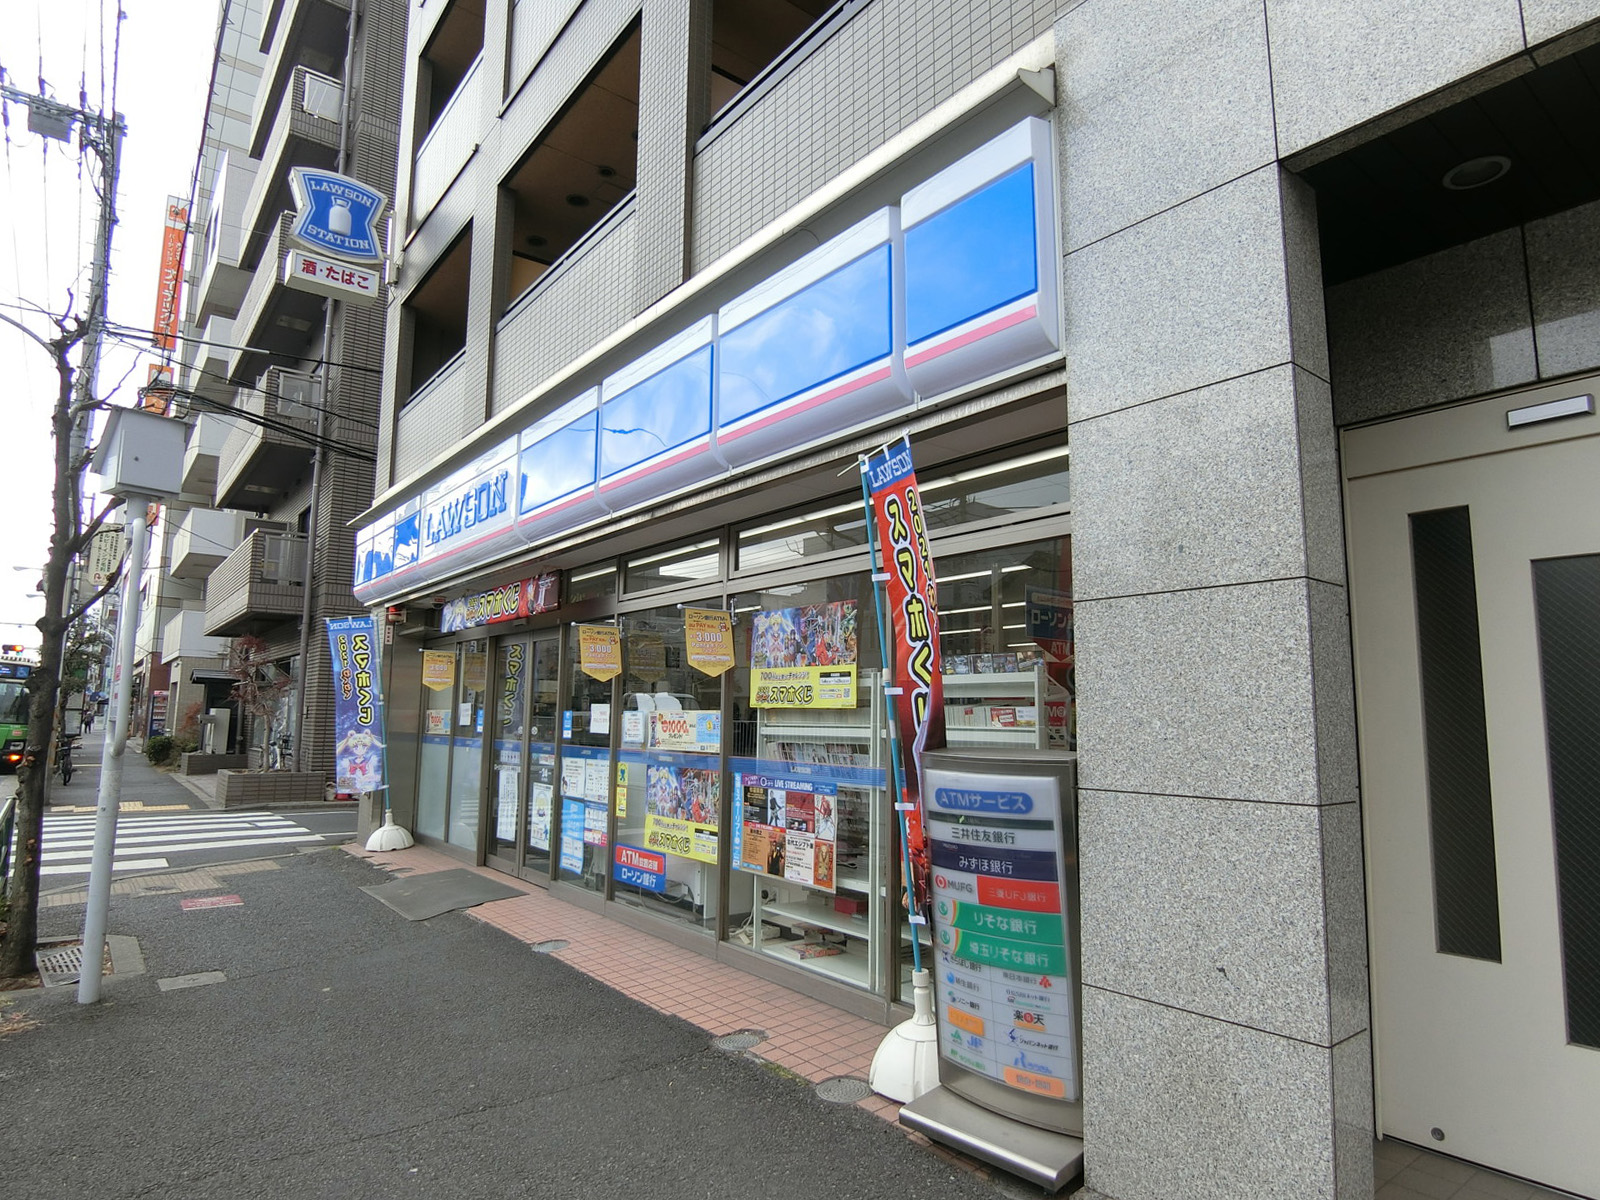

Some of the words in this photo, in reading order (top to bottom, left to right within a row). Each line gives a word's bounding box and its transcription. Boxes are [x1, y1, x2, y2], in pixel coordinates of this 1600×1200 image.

[310, 181, 373, 208] LAWSON
[306, 224, 370, 249] STATION
[869, 449, 912, 487] LAWSON
[425, 470, 508, 548] LAWSON
[477, 583, 521, 620] スマホくじ
[769, 685, 813, 703] スマホくじ
[774, 780, 785, 789] LIVE
[785, 781, 813, 791] STREAMING
[941, 790, 1026, 811] ATMサービス
[951, 827, 1016, 845] 三井住友銀行
[959, 855, 1014, 875] みずほ銀行
[947, 879, 973, 893] MUFG
[988, 887, 1047, 903] 三菱UFJ銀行
[974, 911, 1038, 935] りそな銀行
[969, 941, 1049, 968] 埼玉りそな銀行
